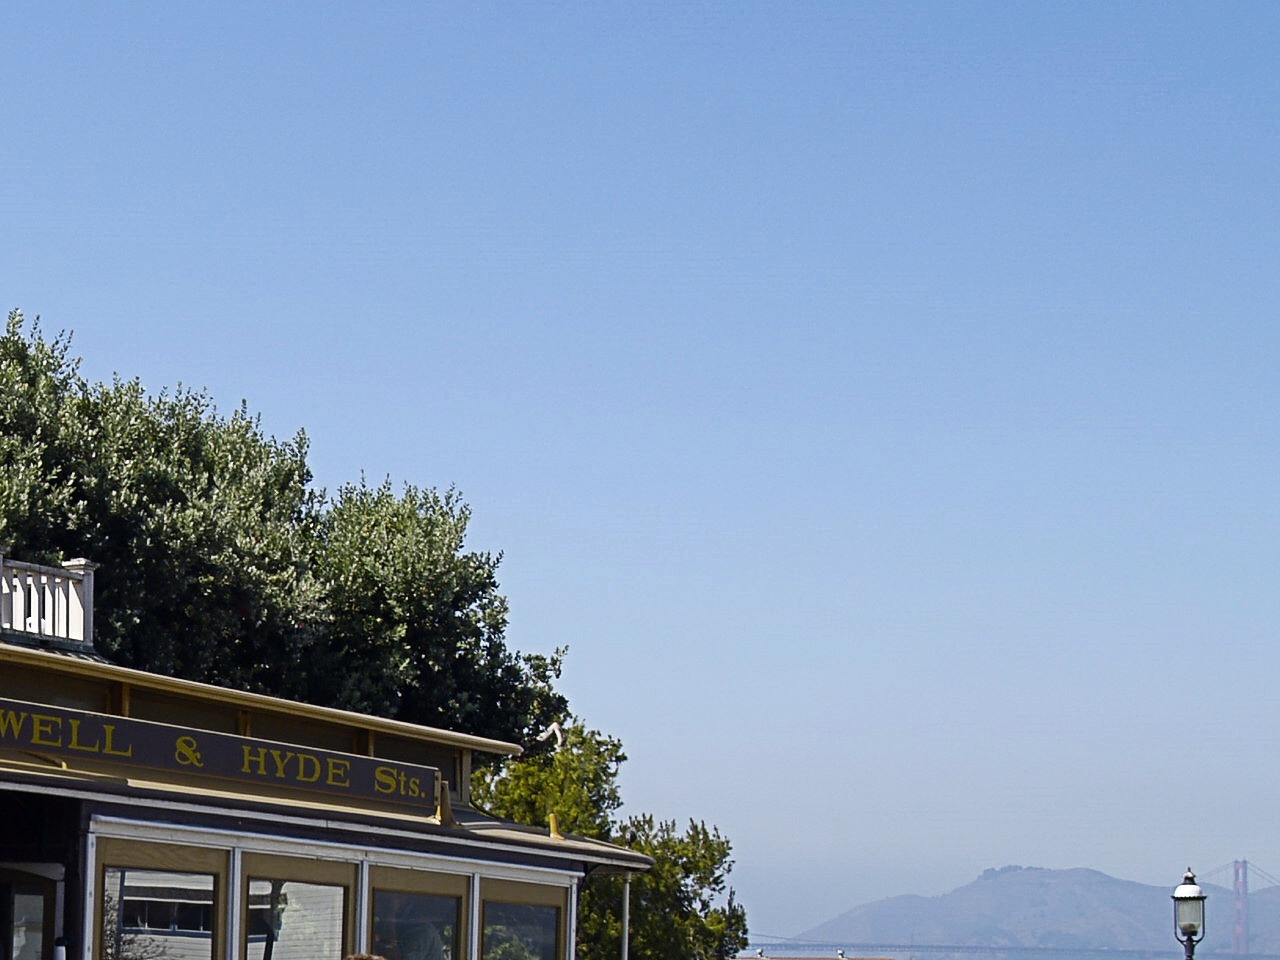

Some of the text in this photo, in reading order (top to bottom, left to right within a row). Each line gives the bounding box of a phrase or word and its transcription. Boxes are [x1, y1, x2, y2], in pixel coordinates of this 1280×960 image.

[174, 735, 204, 768] &
[241, 745, 350, 788] HYDE
[374, 766, 426, 799] Sts.
